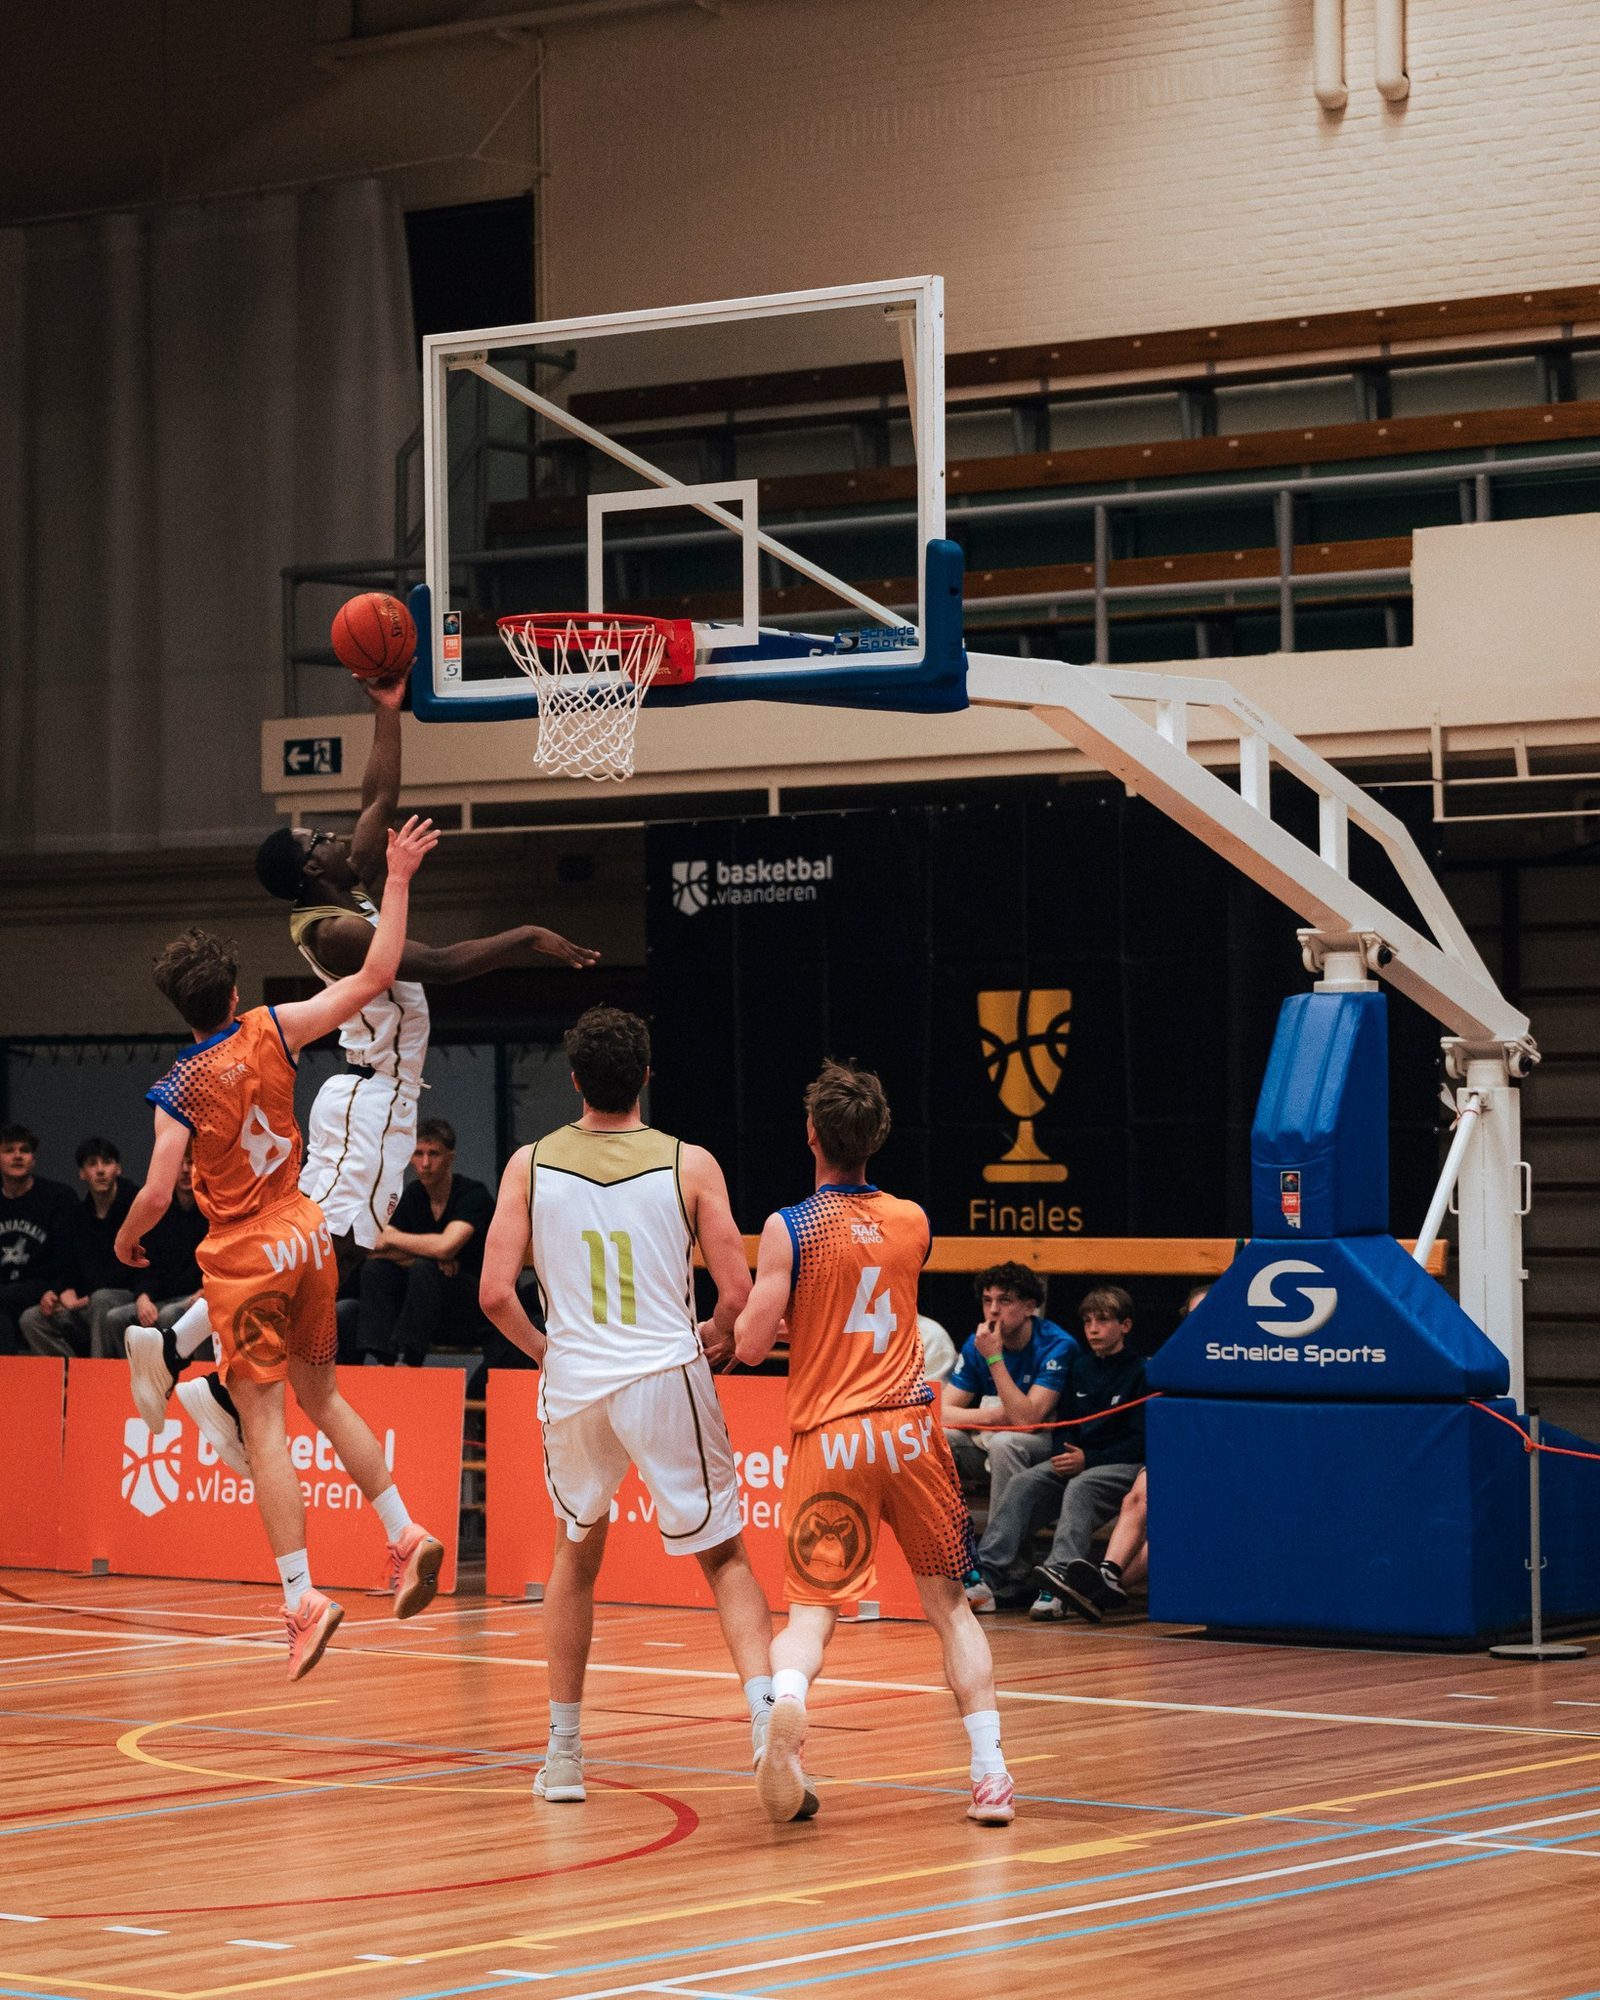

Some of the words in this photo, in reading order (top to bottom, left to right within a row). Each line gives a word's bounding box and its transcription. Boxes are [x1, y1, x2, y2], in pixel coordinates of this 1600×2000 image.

[860, 626, 915, 639] Schelde
[860, 638, 917, 650] Sports
[717, 854, 833, 885] basketbal
[711, 884, 817, 905] .vlaanderen
[970, 1199, 1083, 1232] Finales
[851, 1224, 880, 1236] STAR
[851, 1235, 884, 1245] CASINO
[581, 1230, 637, 1325] 11
[843, 1266, 897, 1354] 4
[1206, 1343, 1299, 1361] Schelde
[1304, 1344, 1386, 1367] Sports
